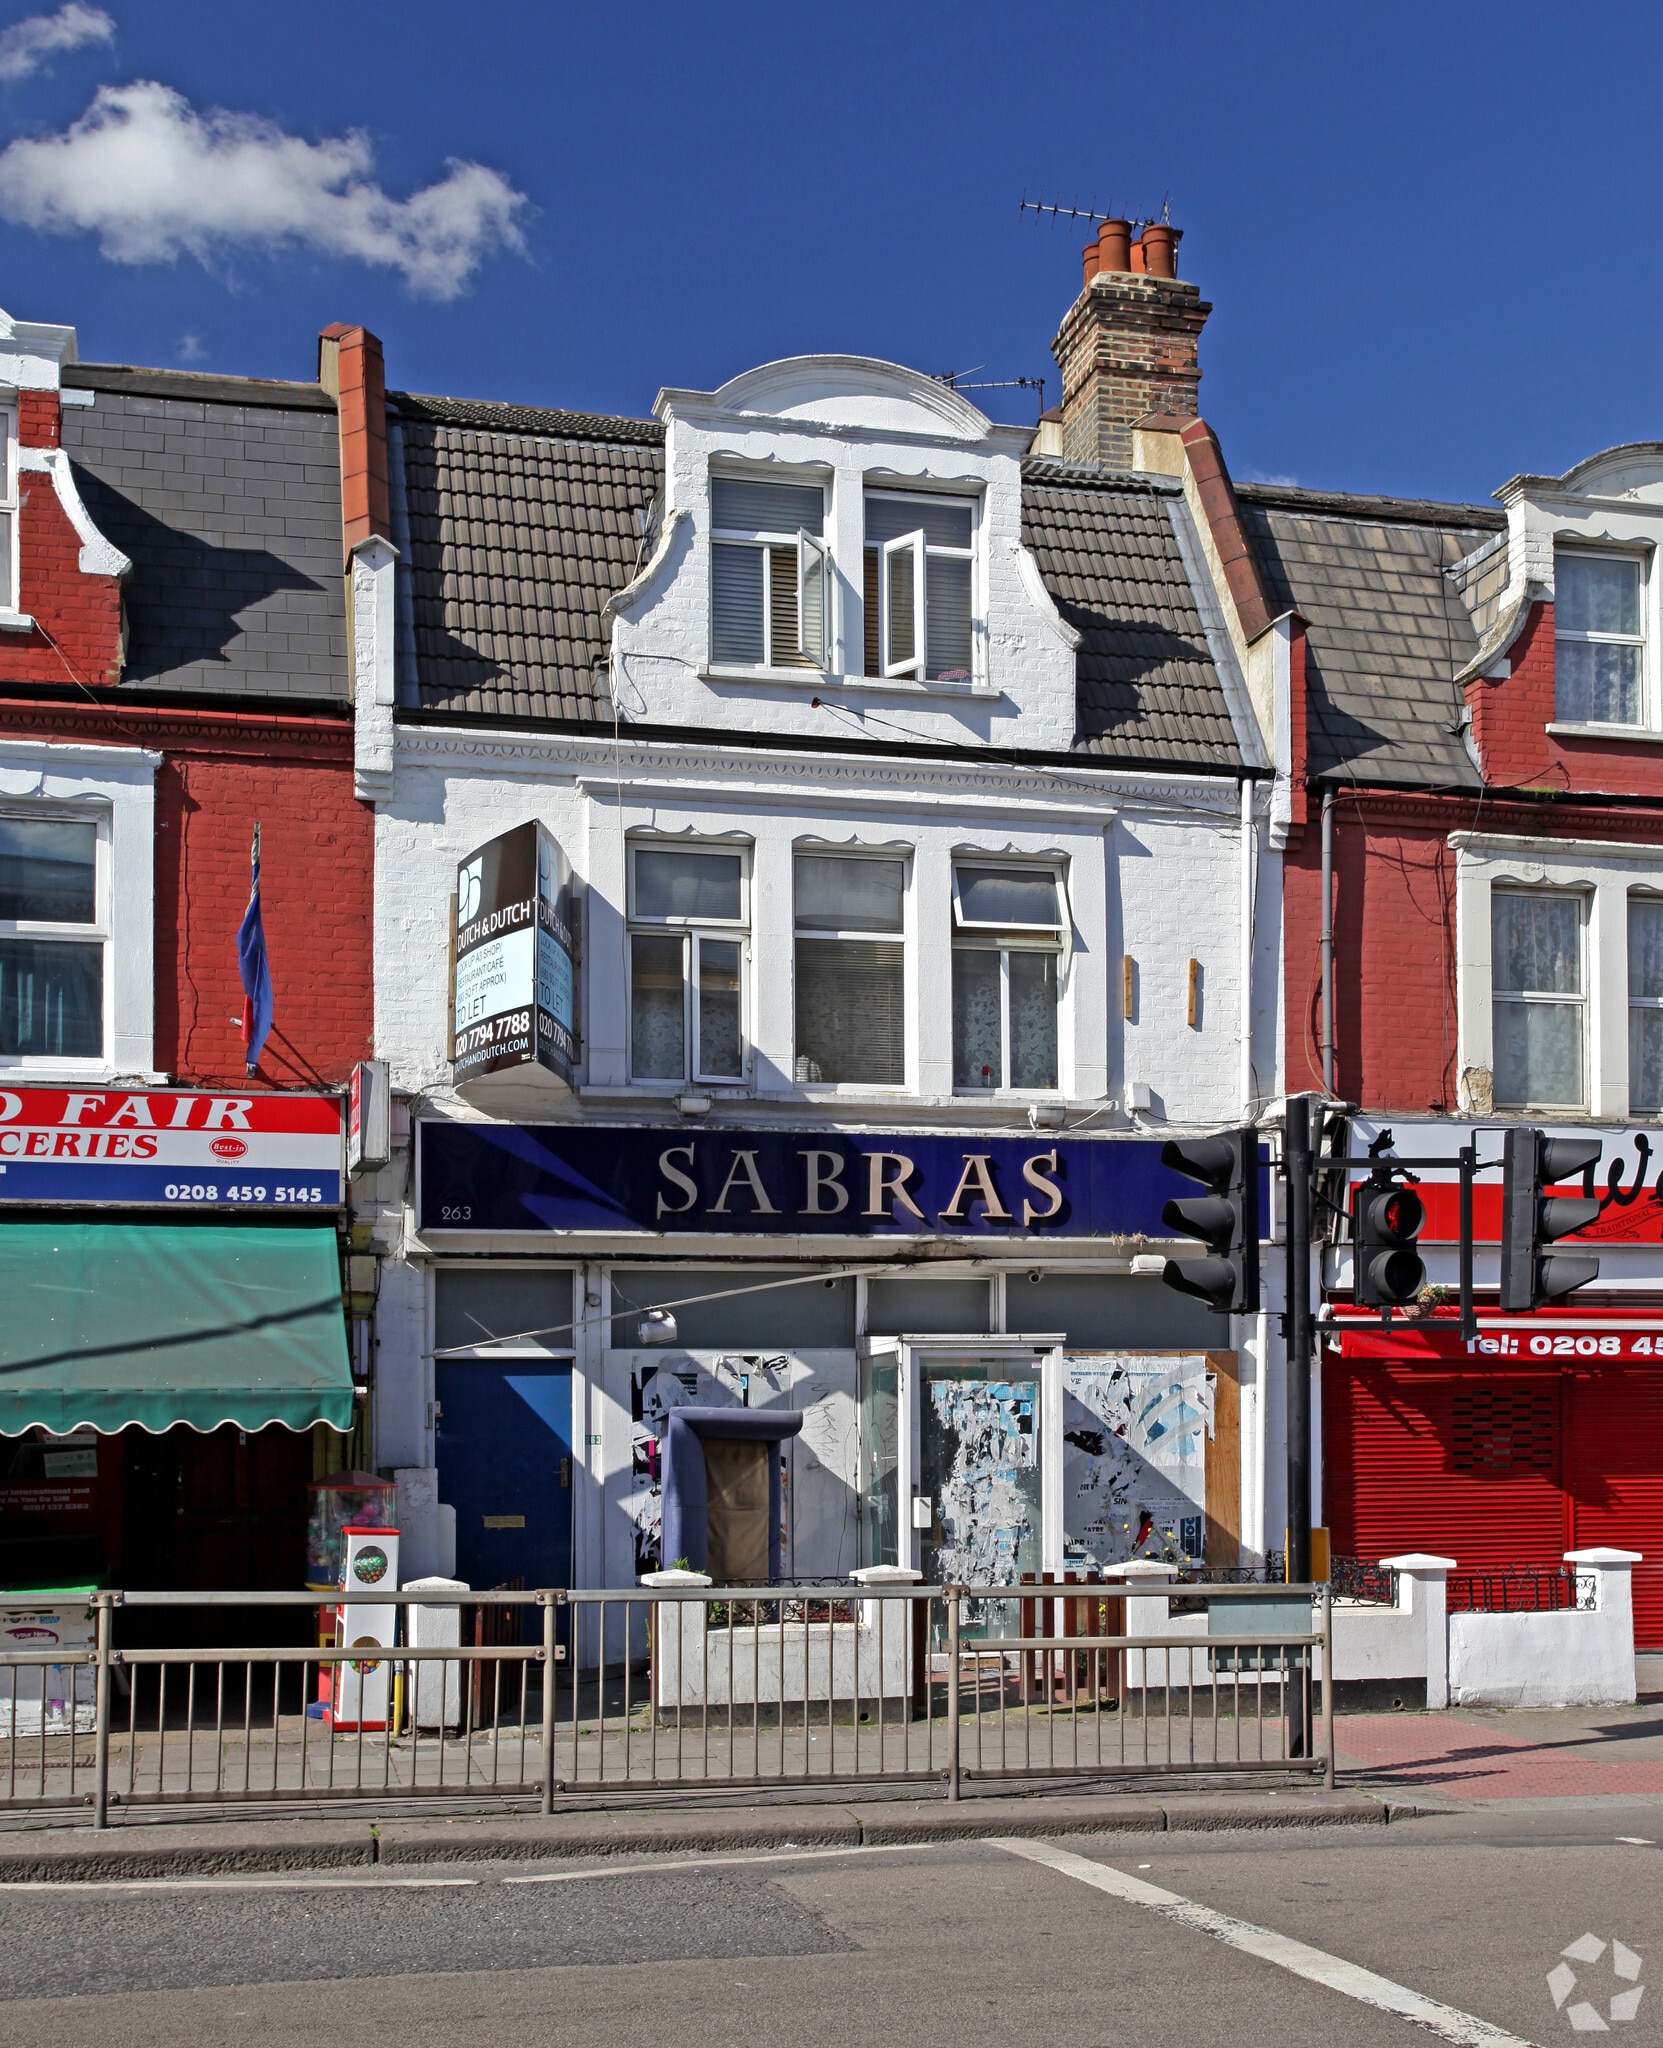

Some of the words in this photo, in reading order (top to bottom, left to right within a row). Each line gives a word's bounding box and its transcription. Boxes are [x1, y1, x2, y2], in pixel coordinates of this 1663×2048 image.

[458, 921, 480, 952] DUTCH
[481, 917, 489, 936] &
[490, 900, 530, 932] DUTCH
[540, 902, 560, 936] DUTCH
[457, 1006, 466, 1027] TO
[468, 994, 487, 1020] LET
[540, 981, 551, 1005] TO
[552, 991, 563, 1016] LET
[455, 1033, 467, 1058] 020
[469, 1022, 493, 1050] 7794
[496, 1011, 530, 1040] 7788
[539, 1013, 553, 1038] 020
[553, 1022, 566, 1051] 7794
[455, 1037, 529, 1074] DUTCHANDDUTCH.COM
[57, 1093, 253, 1129] FAIR
[164, 1184, 219, 1201] 0208
[226, 1186, 267, 1201] 459
[274, 1187, 322, 1202] 5145
[656, 1142, 1063, 1227] SABRAS
[441, 1206, 472, 1221] 263
[1595, 1208, 1651, 1235] TRADITIONAL
[1466, 1333, 1519, 1355] Tel:
[1529, 1335, 1621, 1355] 0208
[585, 1435, 601, 1445] 263
